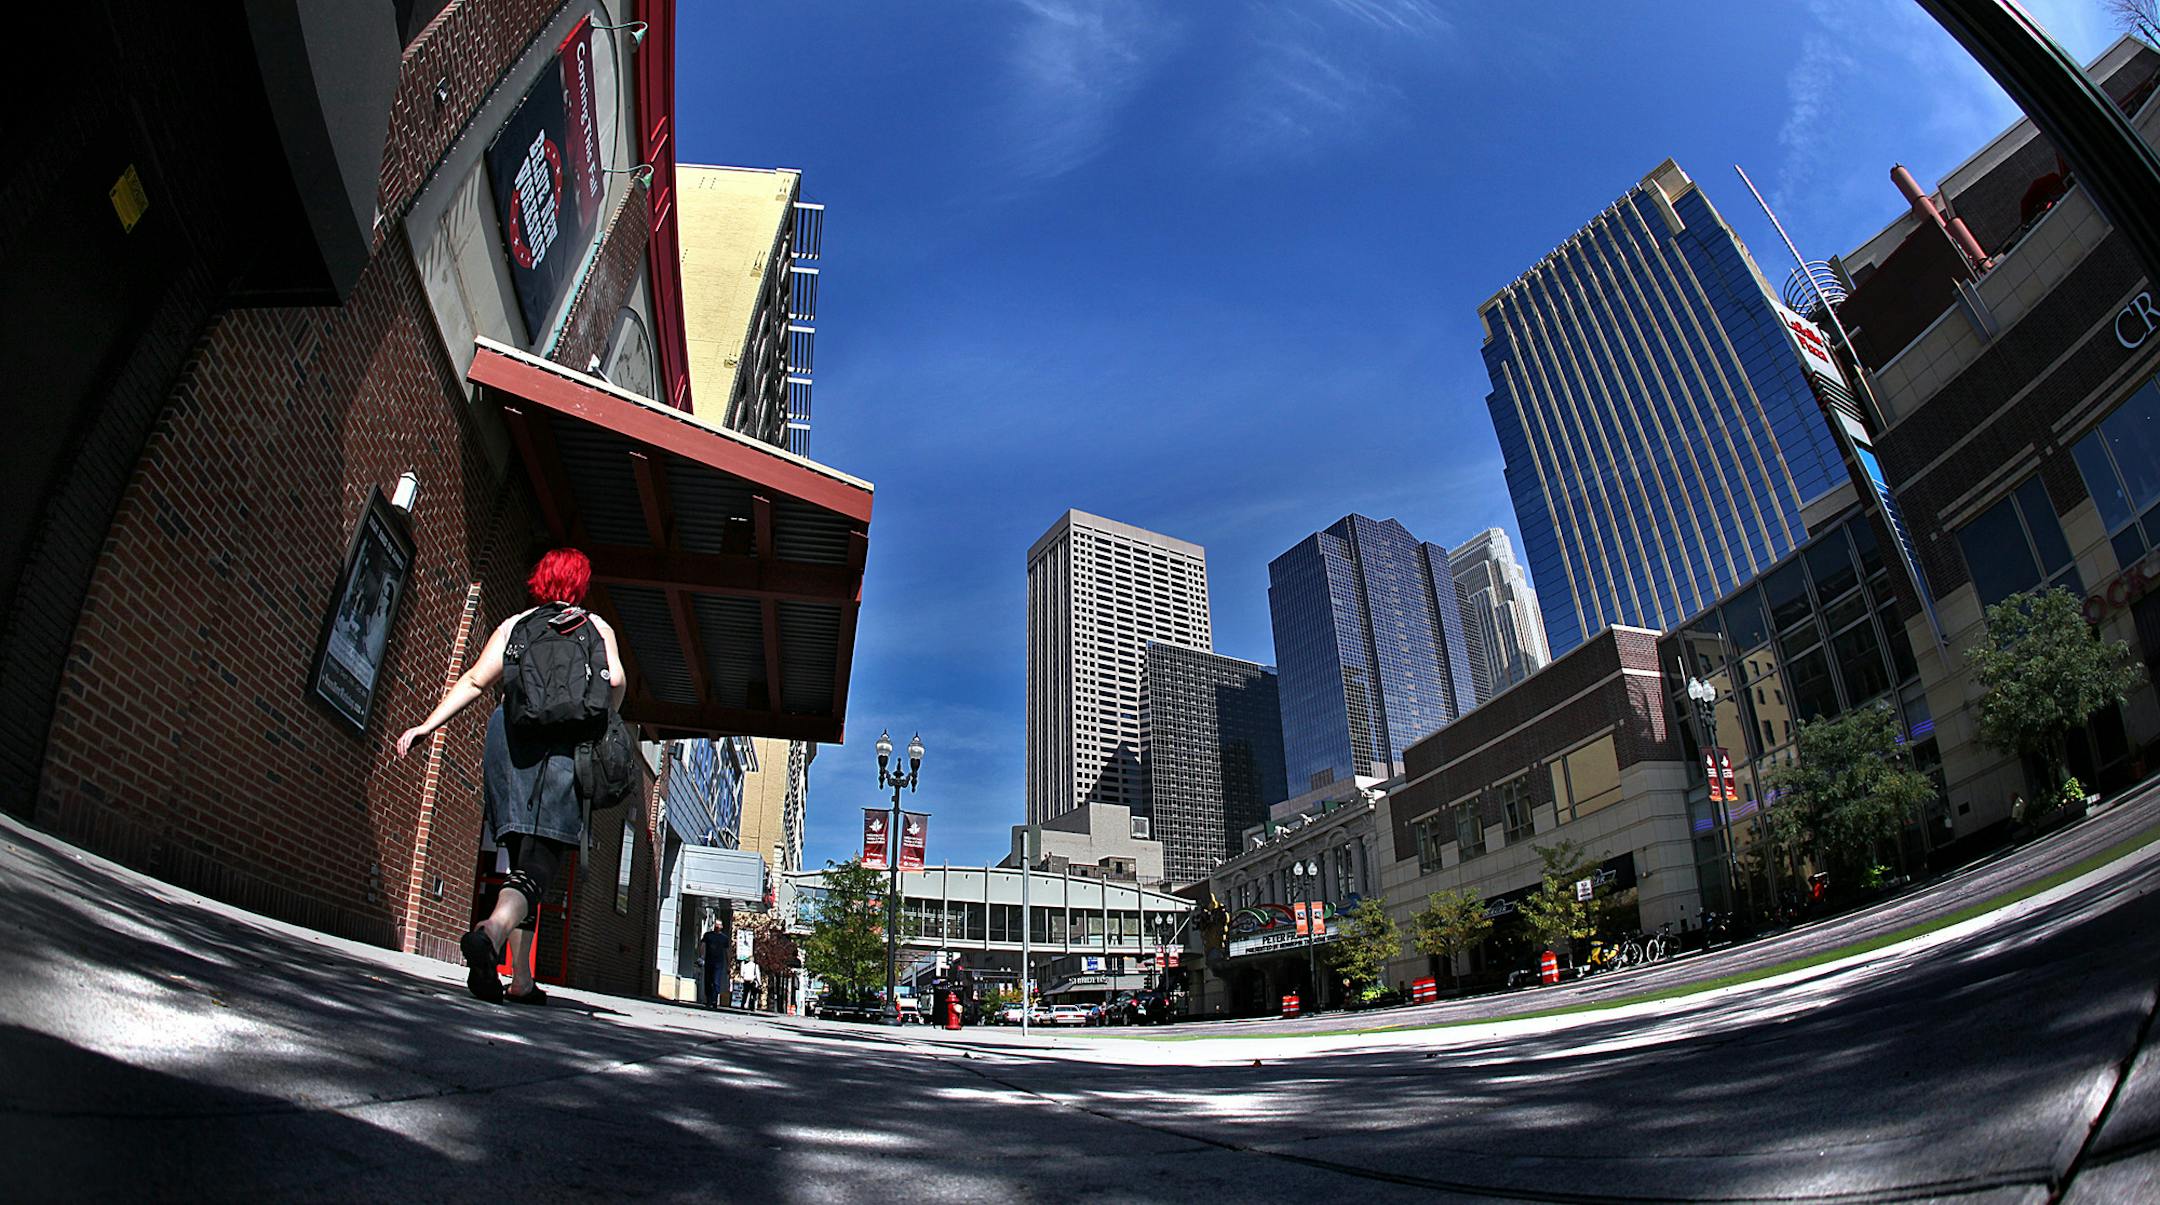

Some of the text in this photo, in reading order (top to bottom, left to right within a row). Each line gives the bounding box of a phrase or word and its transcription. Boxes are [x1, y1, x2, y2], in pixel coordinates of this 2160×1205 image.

[576, 41, 599, 197] Coming This Fall
[514, 156, 546, 270] WORKSHOP
[529, 128, 558, 248] BRAVE NEW
[1794, 332, 1829, 364] Plaza
[1262, 933, 1286, 945] PETER
